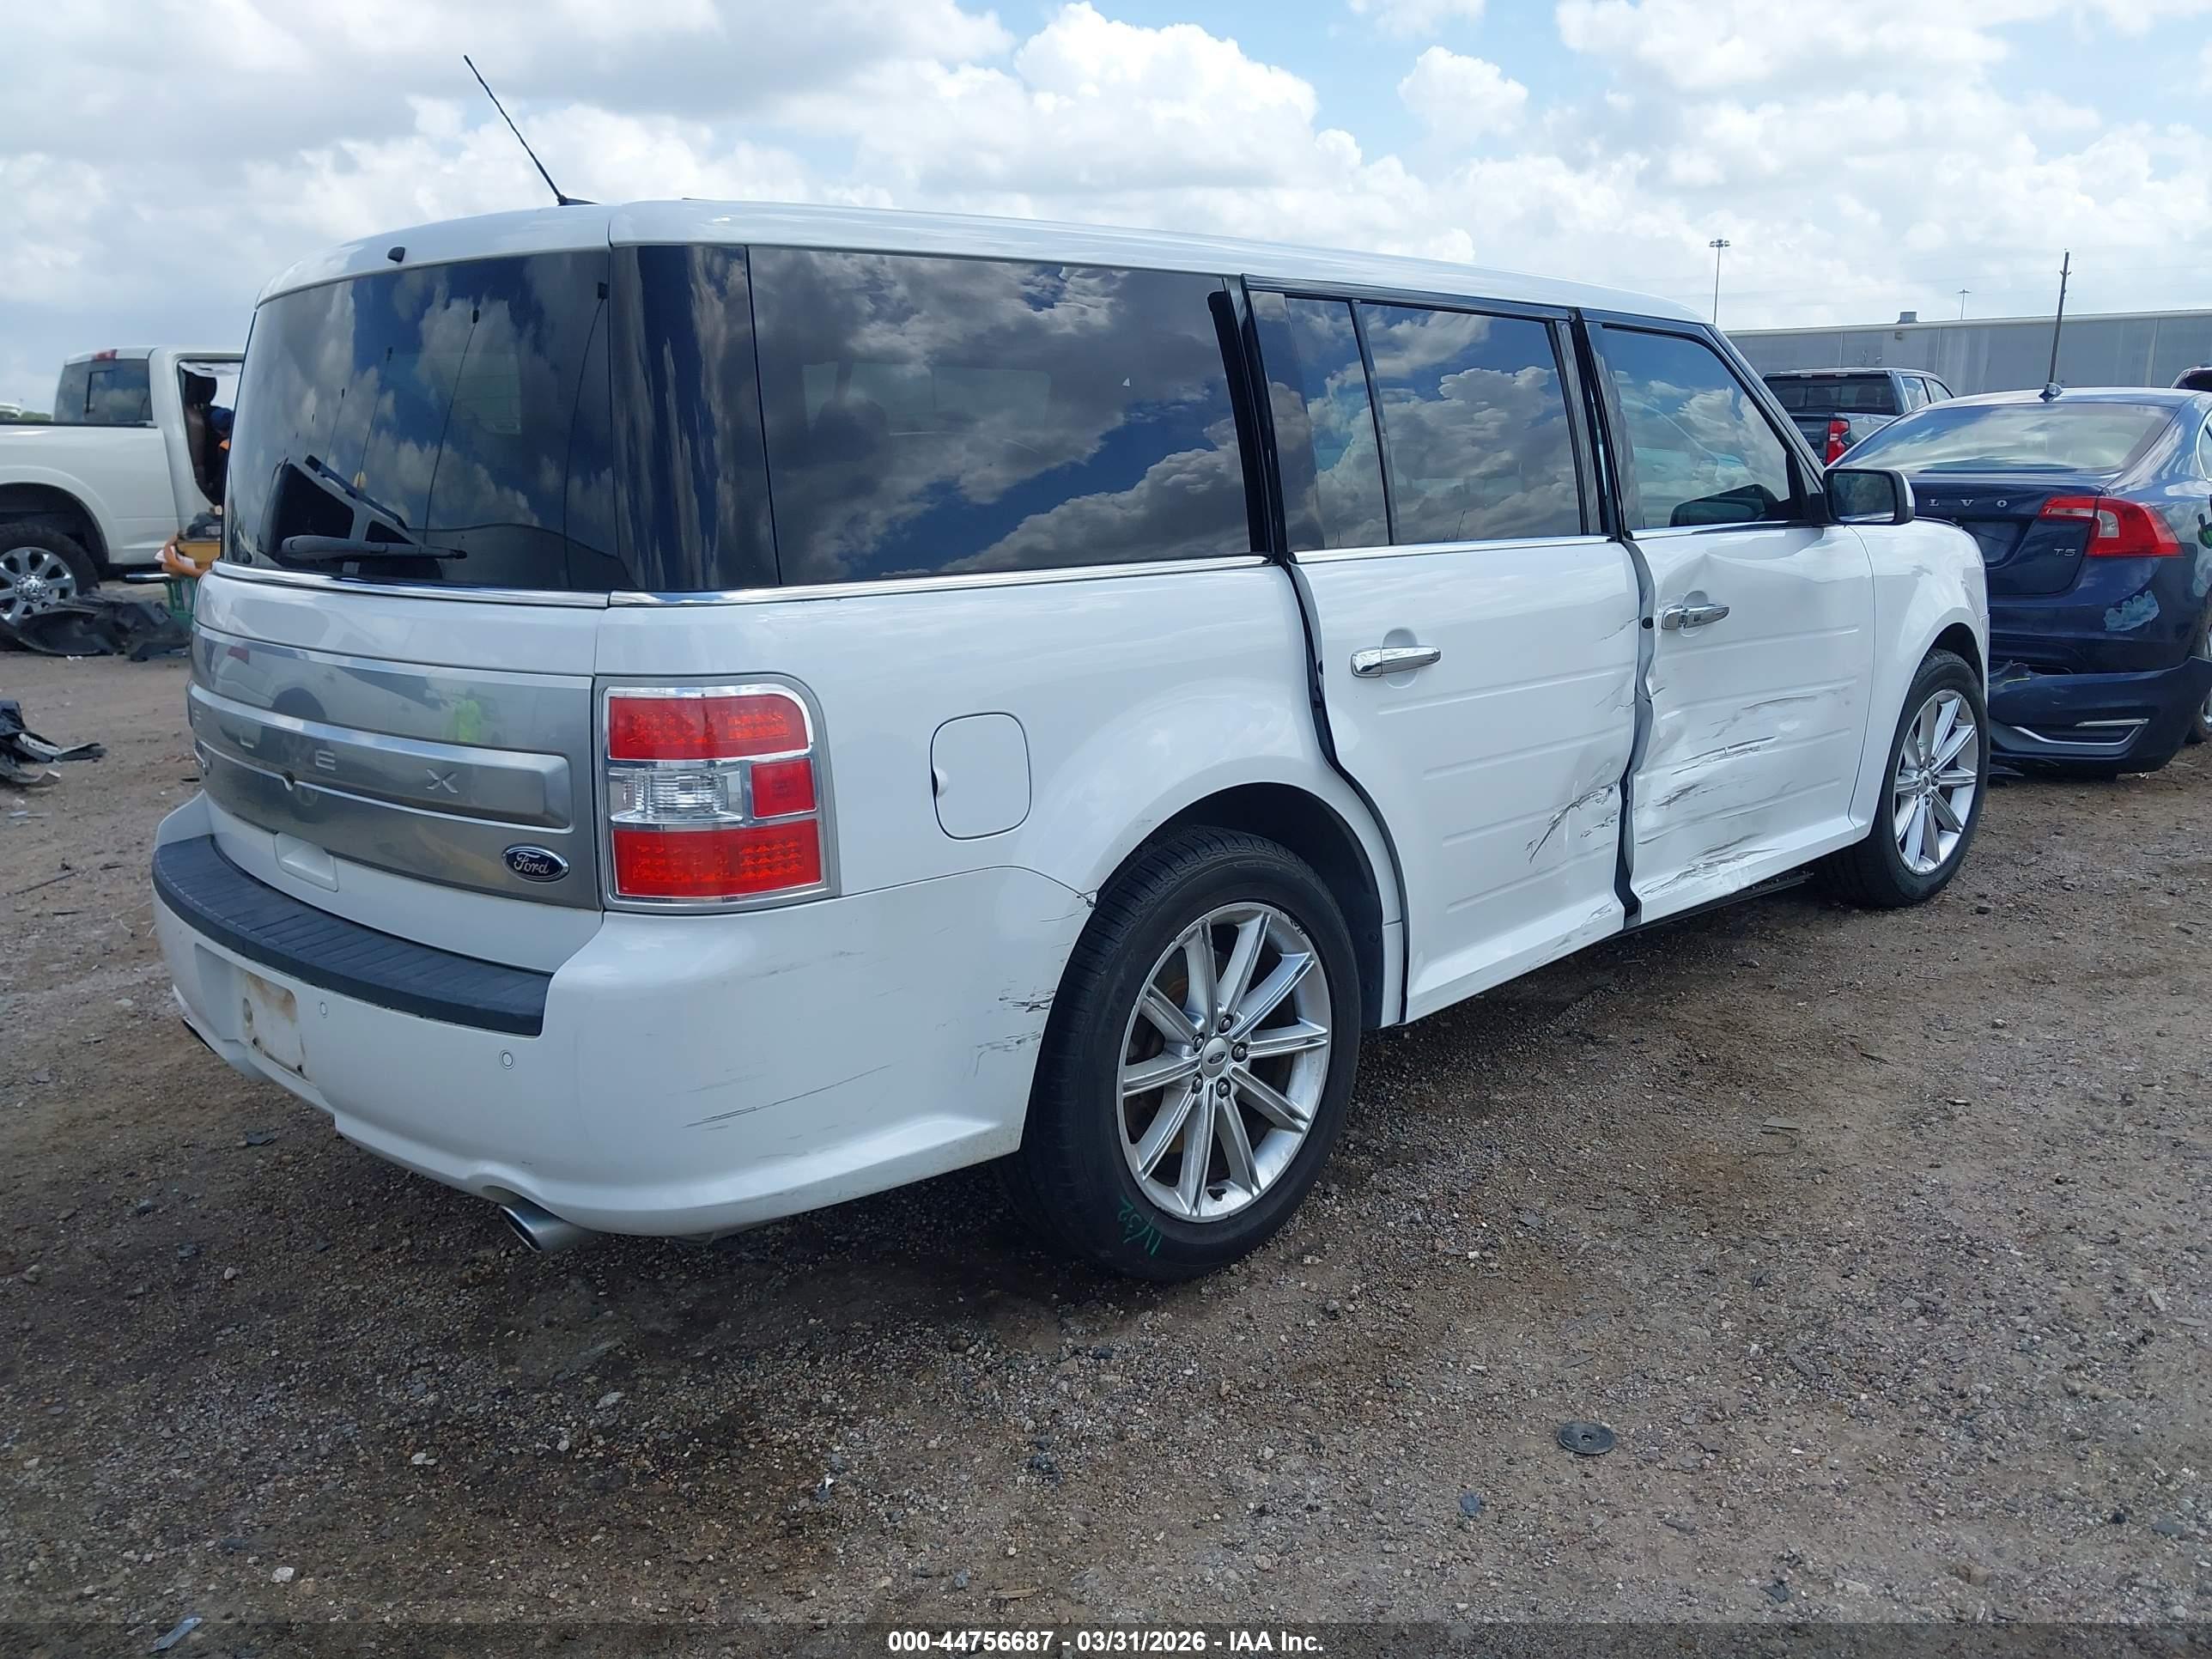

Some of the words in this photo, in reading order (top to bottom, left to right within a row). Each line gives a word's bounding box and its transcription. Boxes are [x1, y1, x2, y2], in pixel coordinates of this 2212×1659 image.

[1929, 498, 2008, 508] LVO
[2053, 548, 2077, 557] T5
[514, 851, 551, 874] Ford
